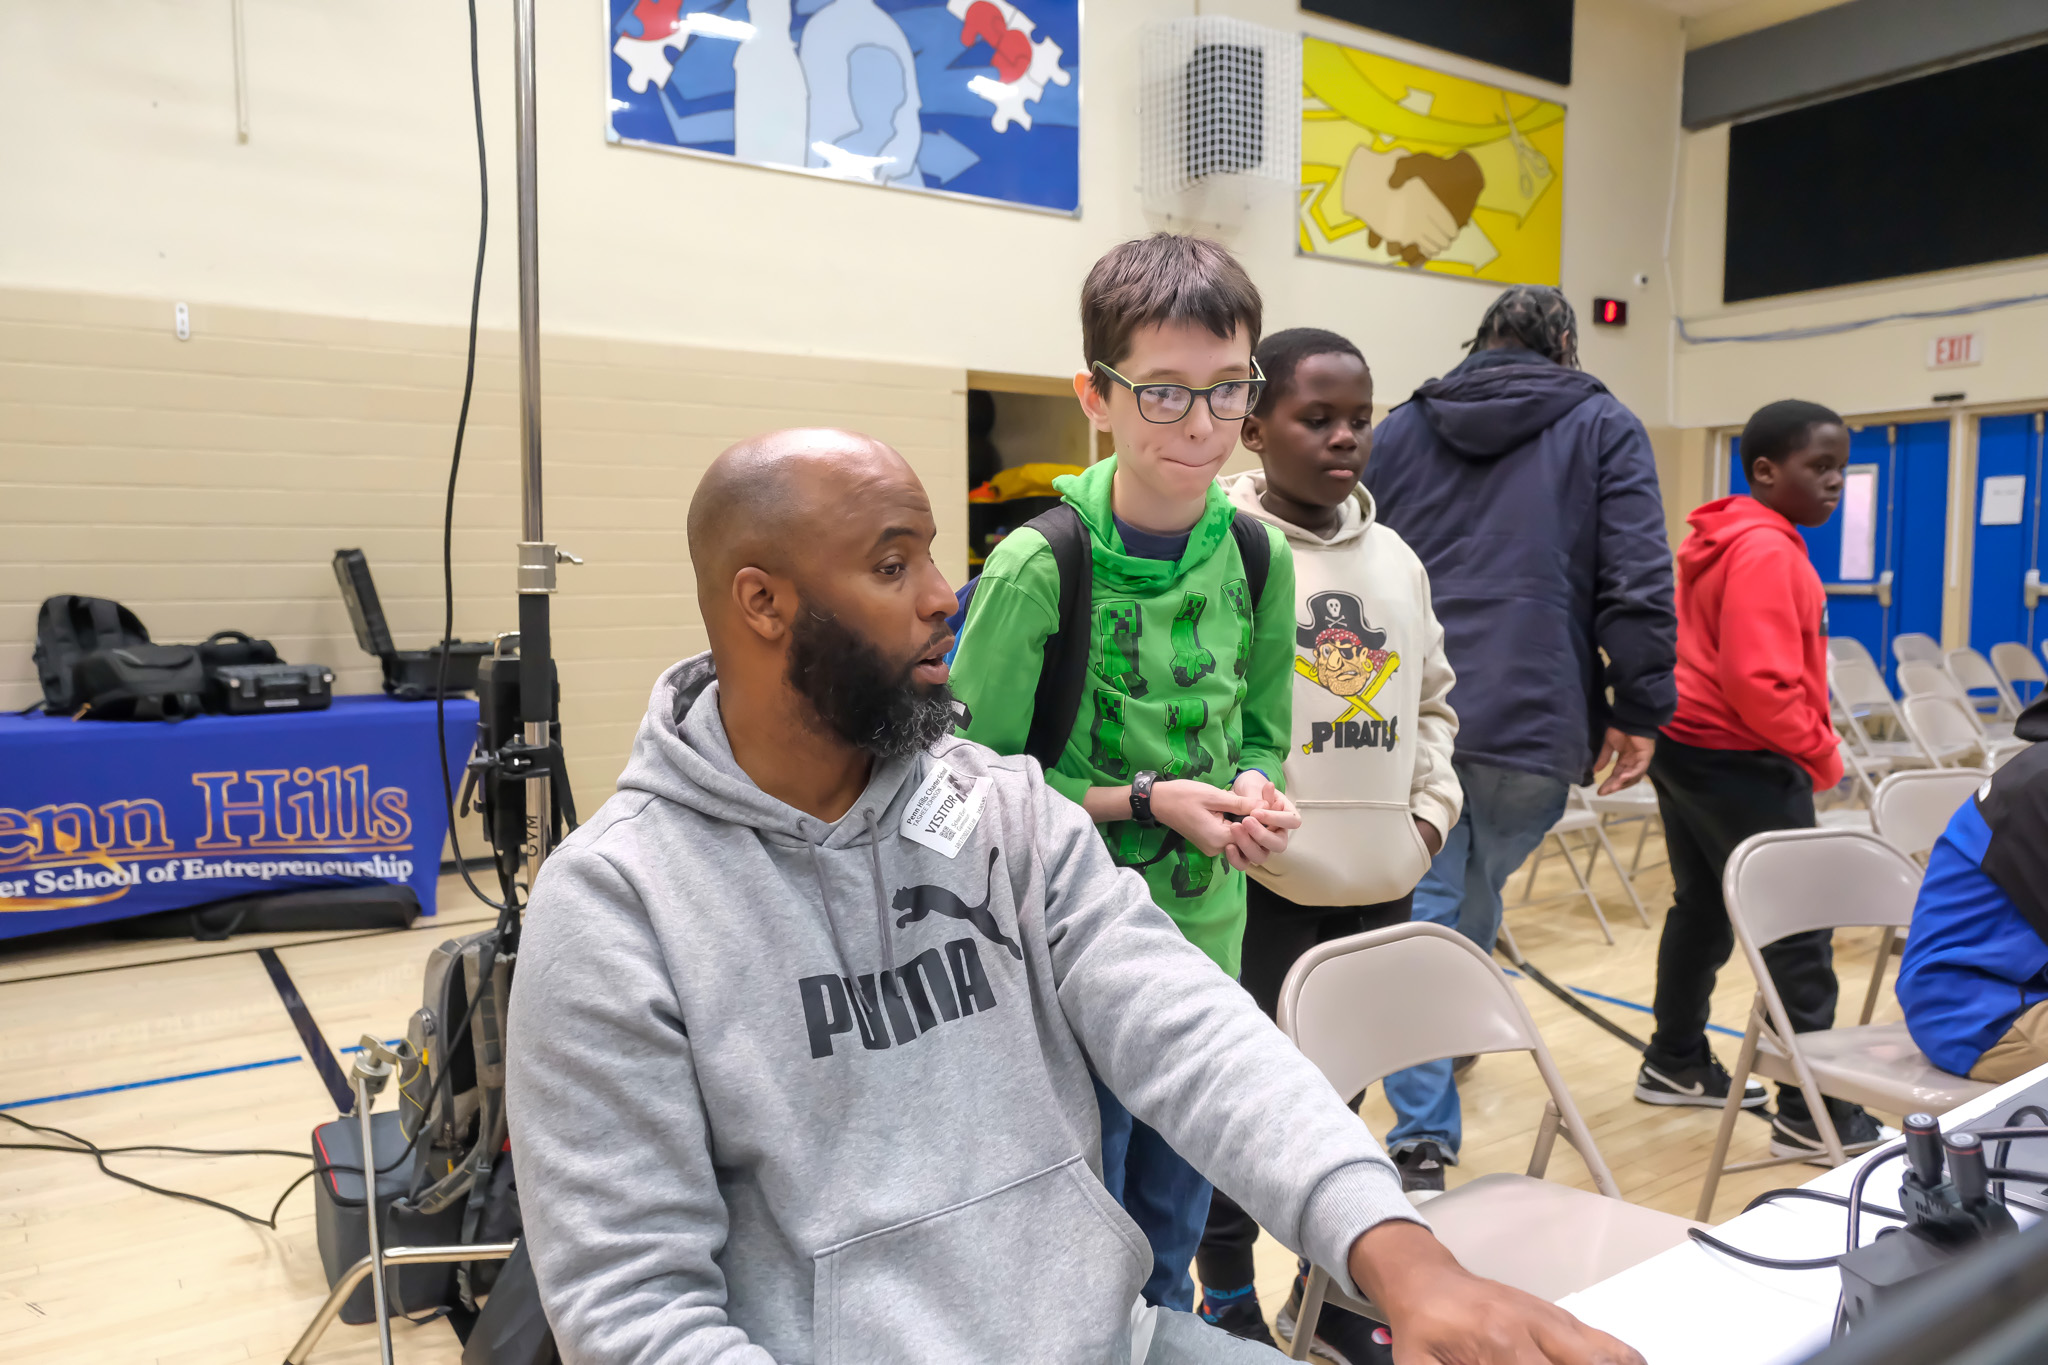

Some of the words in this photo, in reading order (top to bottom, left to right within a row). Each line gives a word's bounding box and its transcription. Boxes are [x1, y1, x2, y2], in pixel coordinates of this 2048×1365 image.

[1936, 334, 1974, 364] EXIT
[1312, 716, 1398, 753] PIRATES
[192, 764, 413, 848] Hills
[906, 808, 920, 825] Penn
[917, 795, 929, 810] Hills
[925, 777, 941, 796] Charter
[938, 766, 949, 782] School
[912, 806, 929, 827] TASHEE
[926, 787, 942, 809] JOHNSON
[924, 794, 958, 835] VISITOR
[526, 814, 539, 857] GYM
[34, 862, 142, 895] School
[146, 859, 180, 883] of
[182, 854, 414, 882] Entrepreneurship
[798, 938, 998, 1059] PUMA
